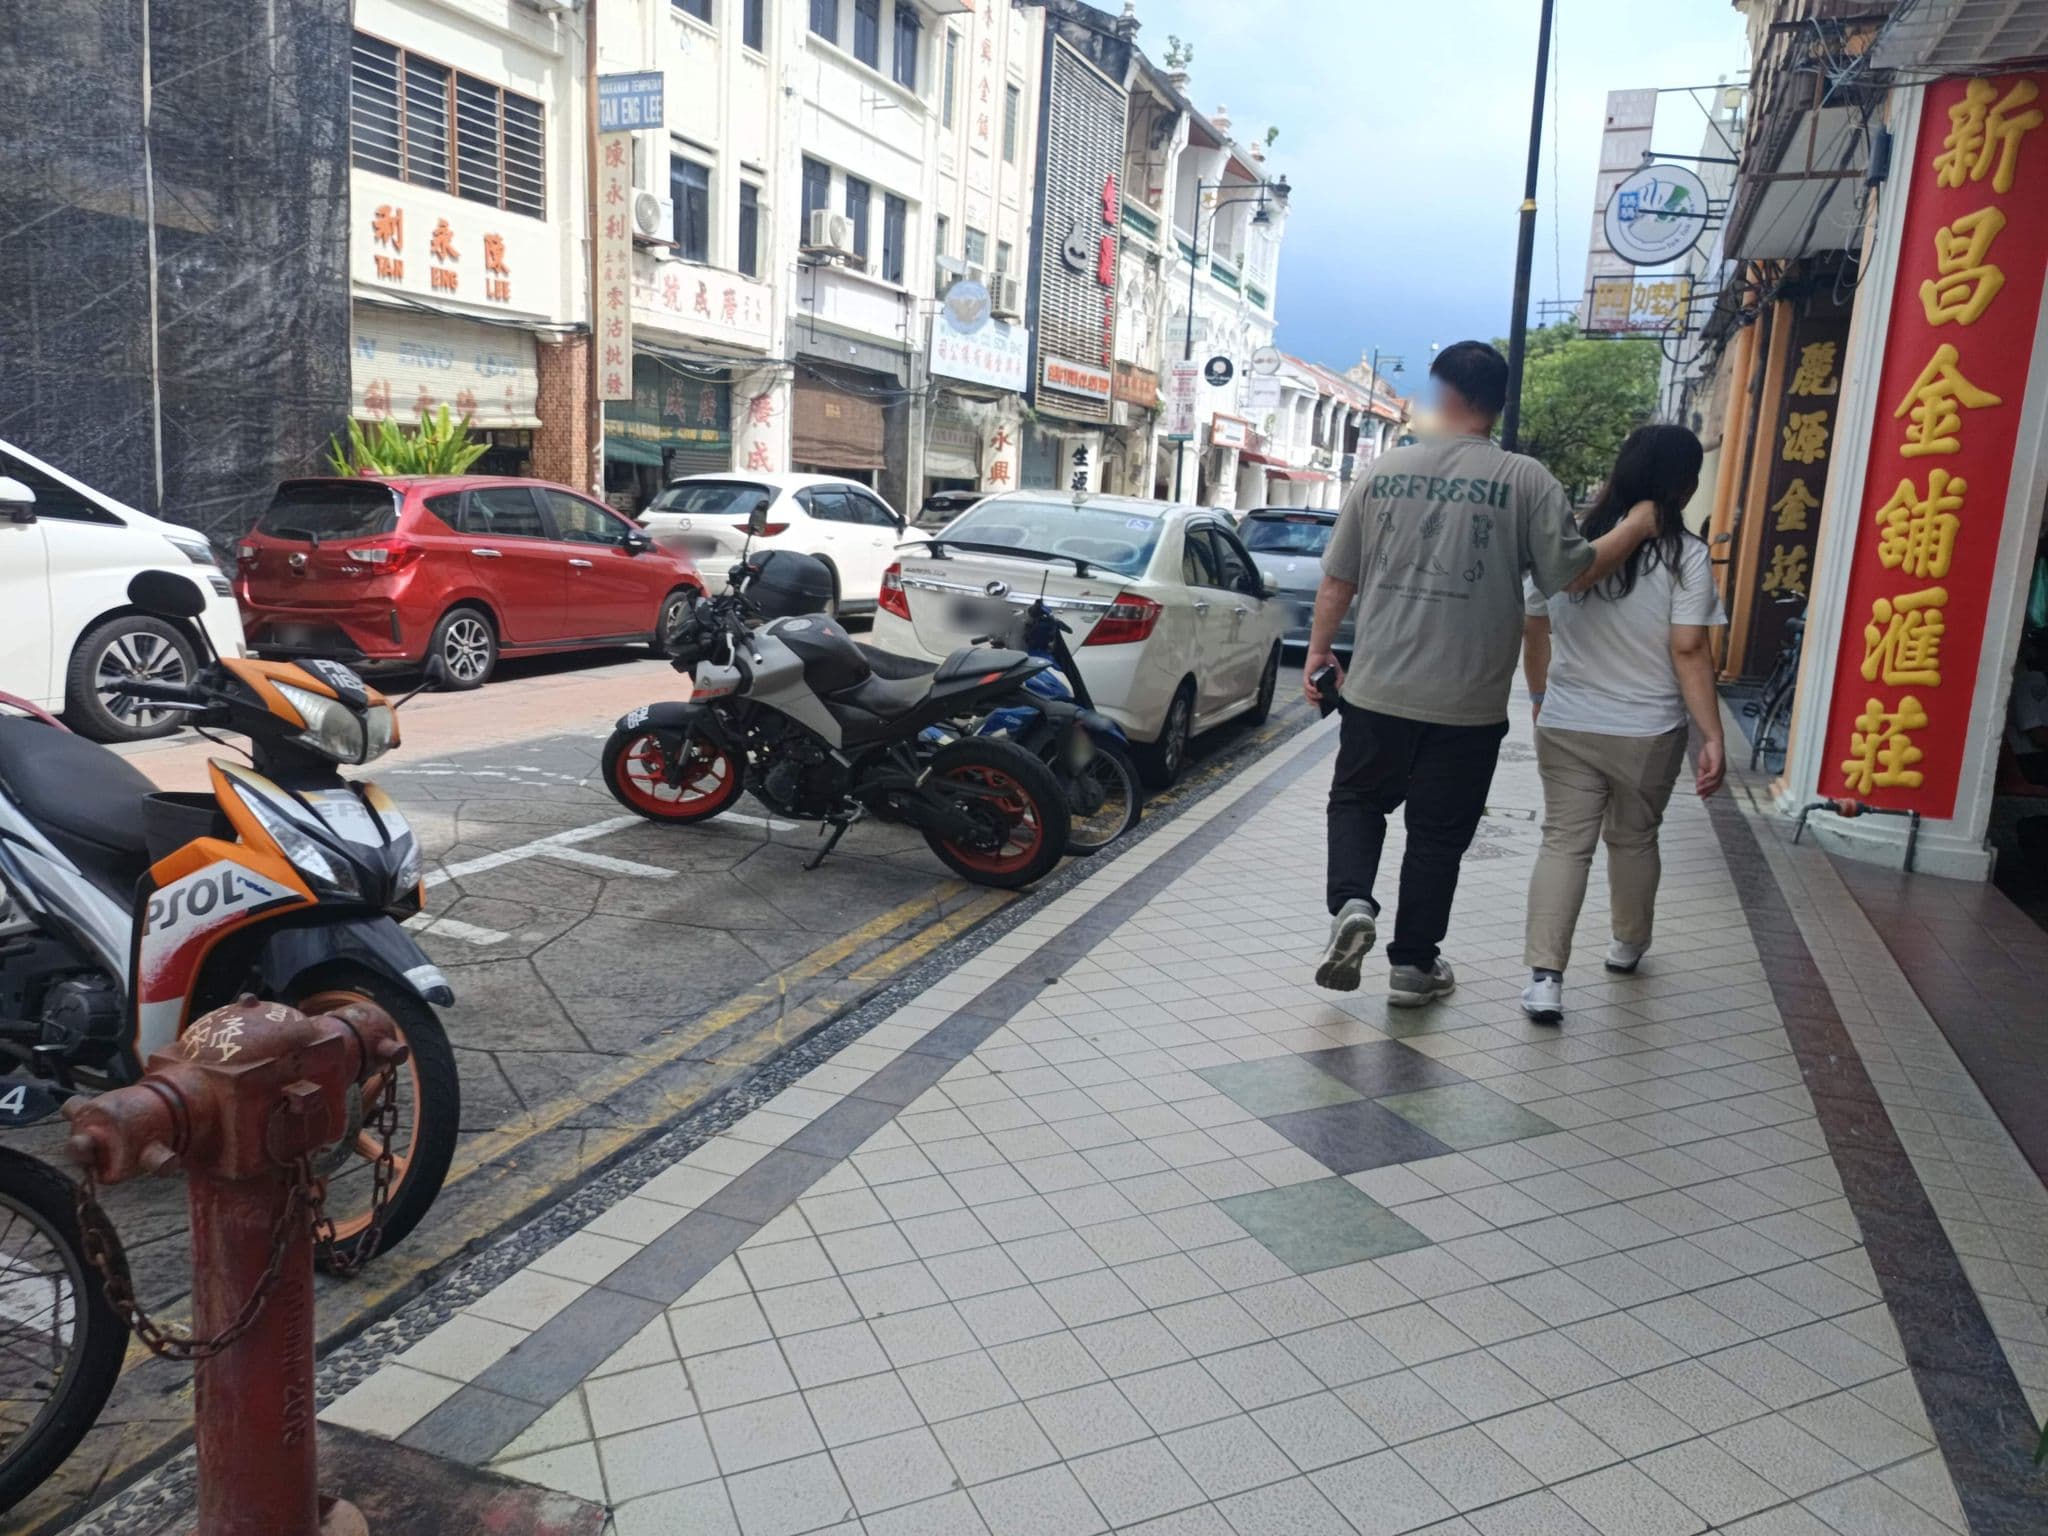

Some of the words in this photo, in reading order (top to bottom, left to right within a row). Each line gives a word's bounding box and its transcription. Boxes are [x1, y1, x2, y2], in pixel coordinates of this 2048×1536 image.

[600, 98, 618, 126] TAN
[622, 96, 640, 124] ENG
[643, 95, 662, 122] LEE
[374, 254, 404, 282] TAN
[430, 266, 458, 293] ENG
[485, 277, 511, 303] LEE
[1371, 475, 1512, 510] REFRESH
